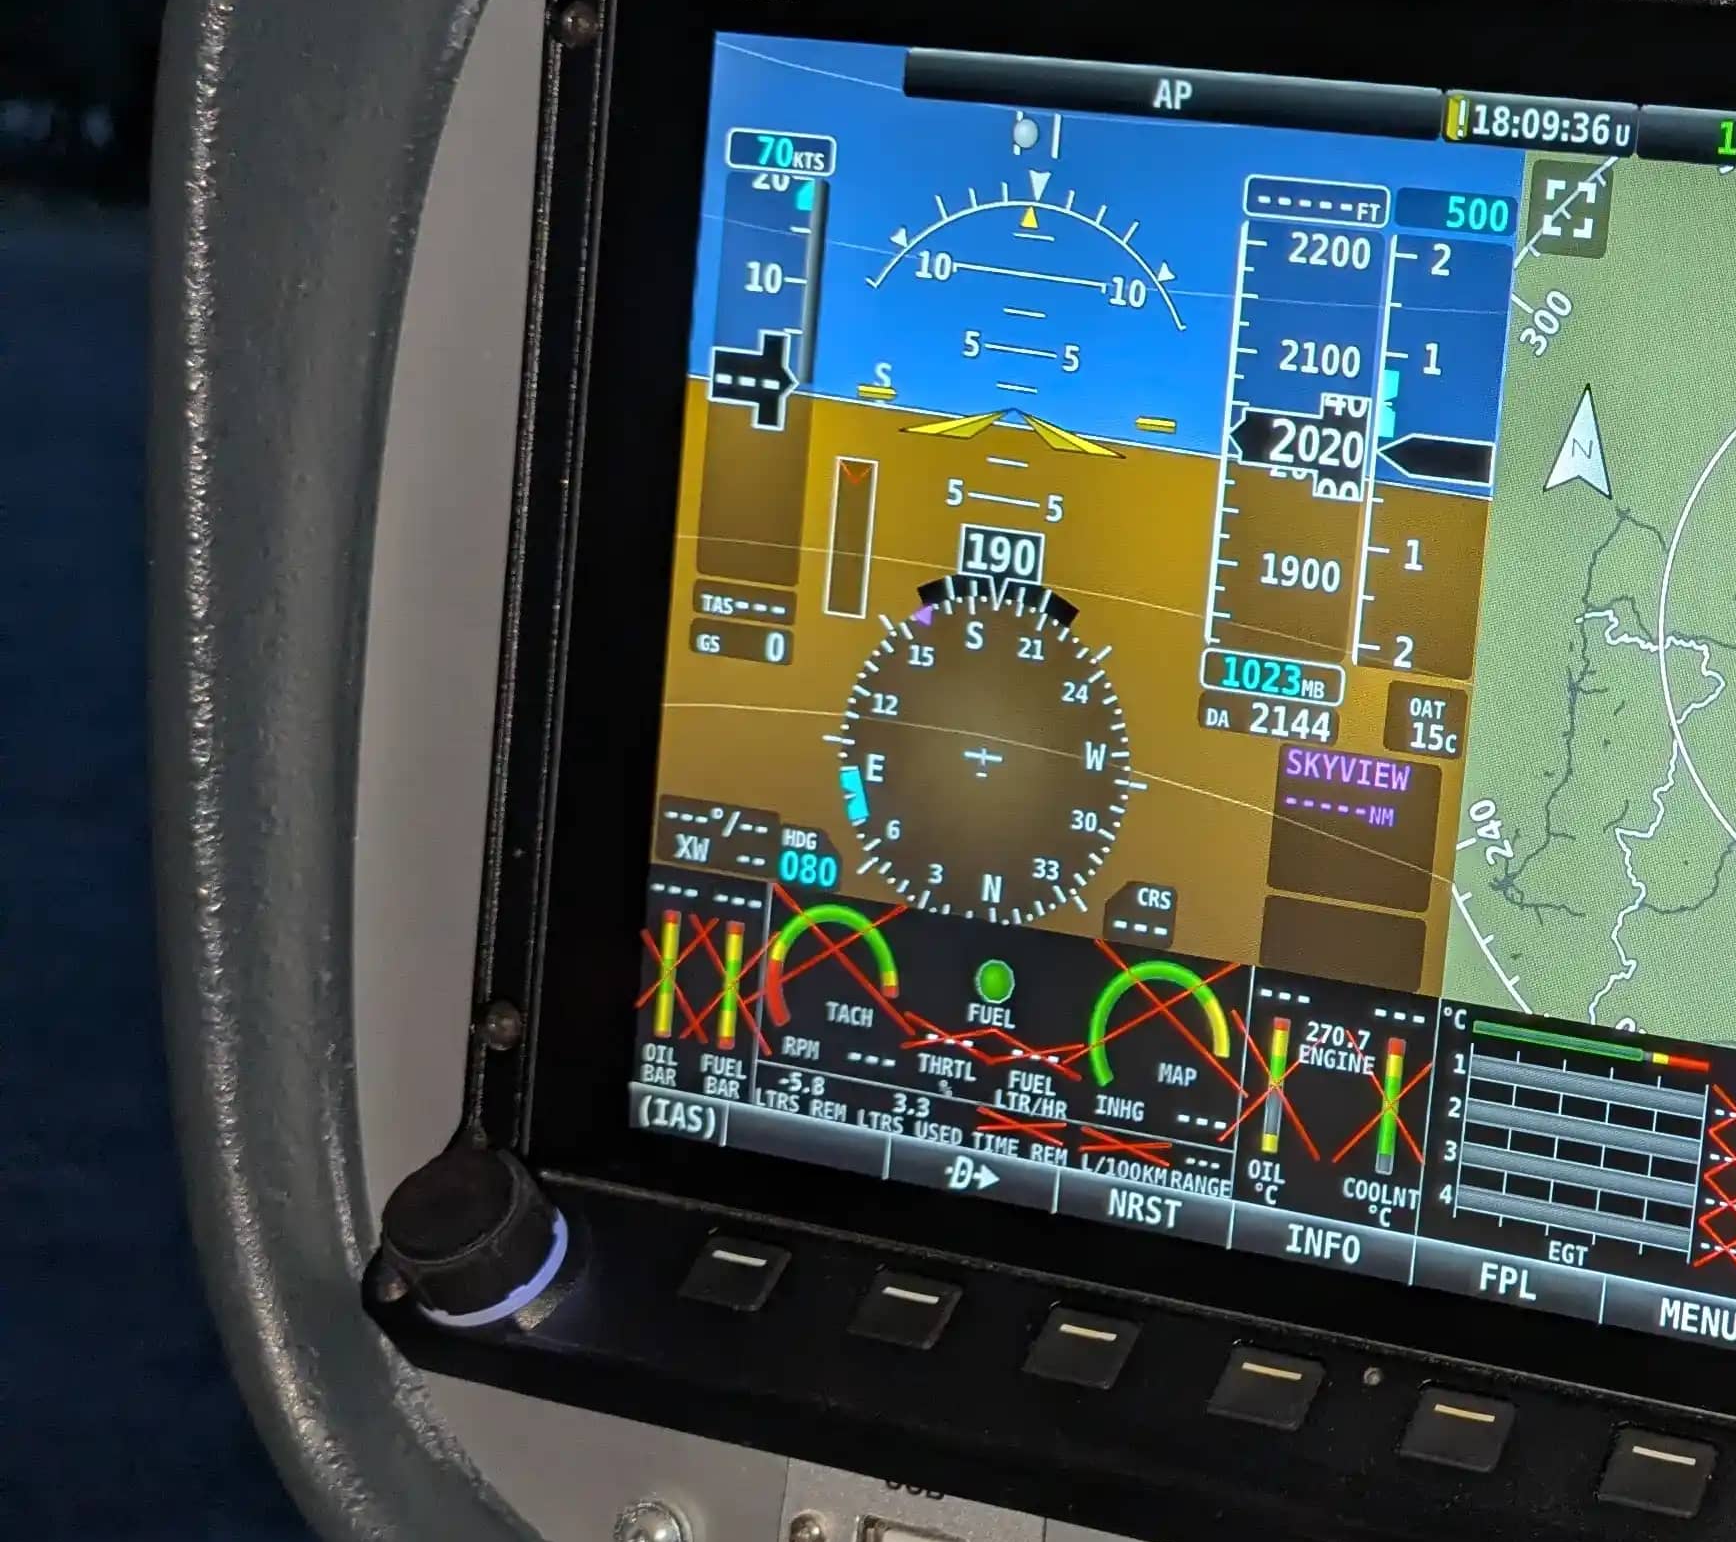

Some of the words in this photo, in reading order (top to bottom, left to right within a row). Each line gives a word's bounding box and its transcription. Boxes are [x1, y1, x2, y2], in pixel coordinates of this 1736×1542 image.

[1153, 79, 1193, 110] AP
[1446, 196, 1509, 232] 500
[1288, 232, 1371, 269] 2200
[1519, 290, 1573, 357] 300
[1279, 339, 1361, 378] 2100
[1269, 418, 1364, 469] 2020
[965, 532, 1036, 576] 190
[1260, 553, 1341, 592] 1900
[1206, 708, 1230, 728] DA
[1250, 703, 1331, 743] 2144
[1409, 698, 1446, 720] OAT
[1286, 749, 1411, 791] SKYVIEW
[782, 828, 818, 851] HDG
[779, 850, 838, 888] 080
[825, 1001, 873, 1027] TACH
[967, 1003, 1015, 1029] FUEL
[641, 1043, 678, 1067] OIL
[782, 1036, 820, 1060] RPM
[1298, 1044, 1376, 1076] ENGINE
[640, 1065, 676, 1087] BAR
[700, 1053, 747, 1080] FUEL
[918, 1053, 977, 1082] THRTL
[1157, 1063, 1197, 1087] MAP
[704, 1076, 740, 1100] BAR
[1008, 1070, 1056, 1097] FUEL
[639, 1095, 716, 1139] (IAS)
[994, 1089, 1068, 1119] LTR/HR
[1094, 1094, 1144, 1122] INHG
[1248, 1159, 1286, 1185] OIL
[1109, 1188, 1183, 1228] NRST
[1343, 1177, 1419, 1210] COOLNT
[1286, 1224, 1360, 1264] INFO
[1548, 1241, 1589, 1266] EGT
[1479, 1262, 1537, 1301] FPL
